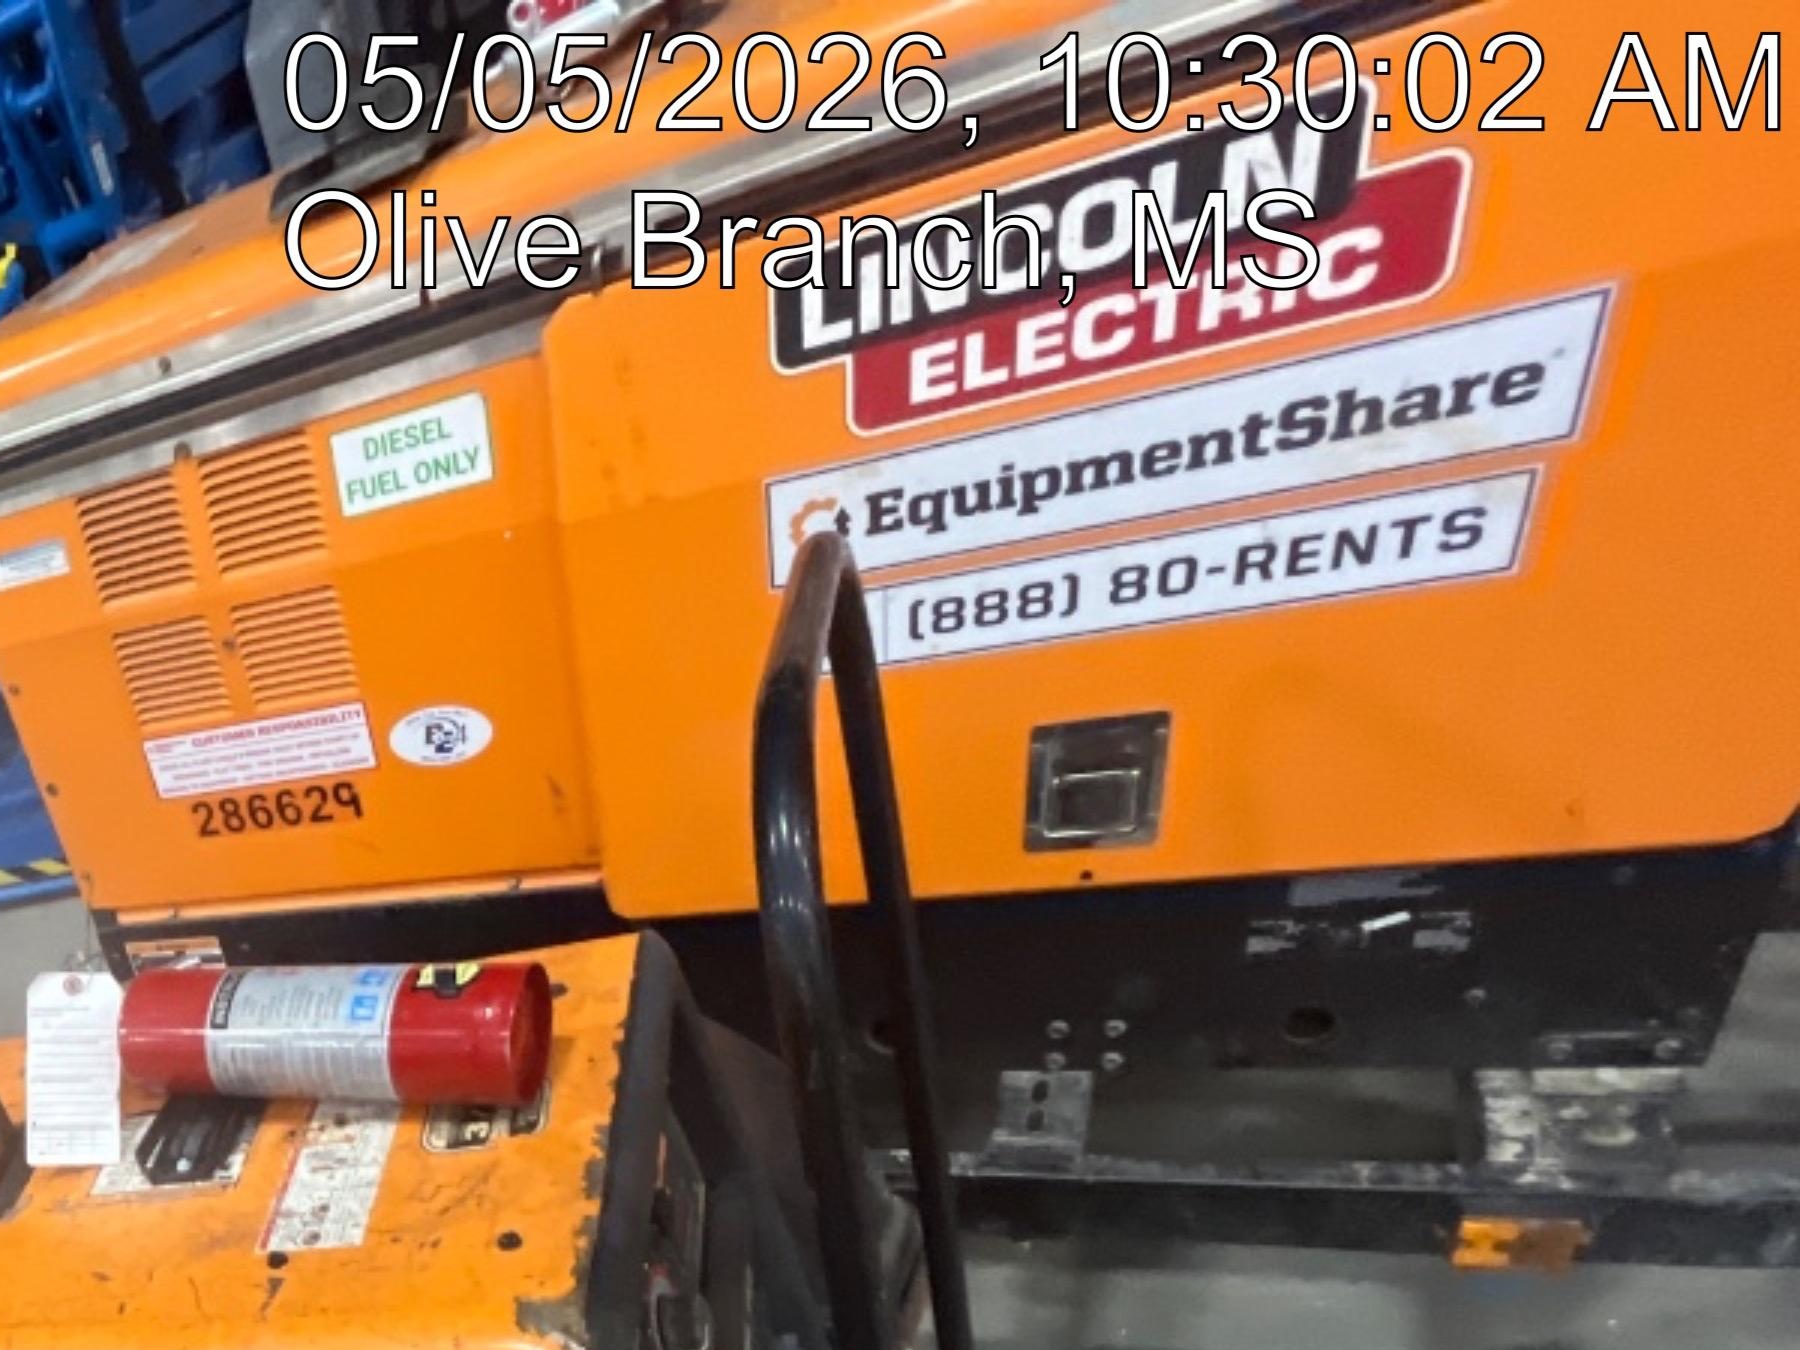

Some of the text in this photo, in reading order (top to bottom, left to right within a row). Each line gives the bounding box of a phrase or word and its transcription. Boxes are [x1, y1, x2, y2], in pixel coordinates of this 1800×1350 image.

[800, 112, 1327, 350] LINCOLN
[908, 225, 1384, 406] ELECTRIC
[345, 445, 480, 505] FUEL ONLY
[362, 416, 453, 461] DIESEL
[864, 350, 1545, 537] EquipmentShare
[907, 506, 1488, 640] (888) 80-RENTS
[191, 781, 364, 838] 286629
